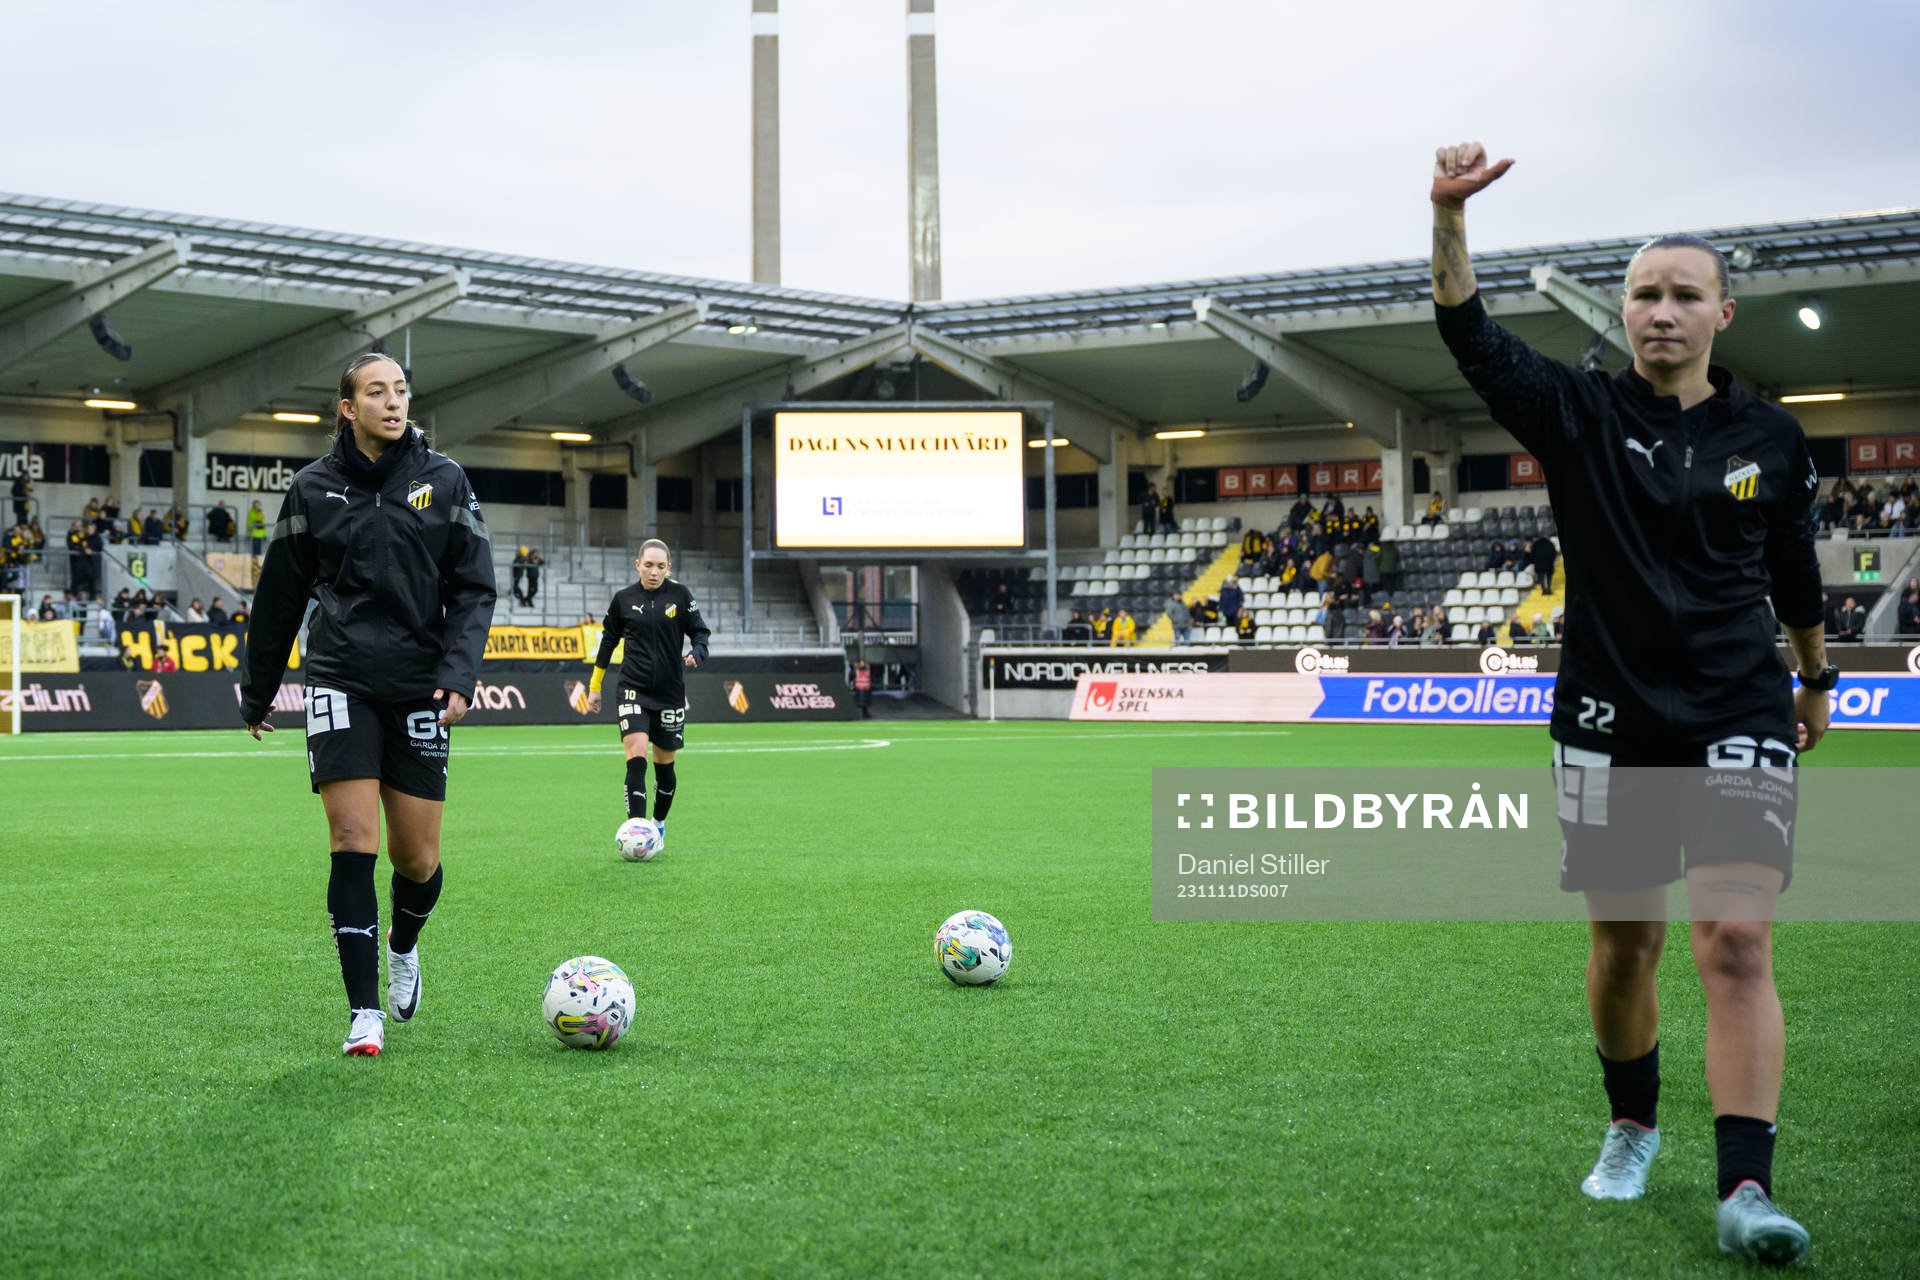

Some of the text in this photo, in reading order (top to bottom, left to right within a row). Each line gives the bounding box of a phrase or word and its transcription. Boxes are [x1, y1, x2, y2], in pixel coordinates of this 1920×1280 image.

[789, 432, 1009, 451] DAGENS MATCHVÄRD
[211, 455, 295, 491] bravida
[1224, 472, 1294, 489] BRA
[131, 559, 145, 578] G
[1860, 552, 1873, 571] F
[624, 688, 637, 701] 10
[775, 683, 821, 697] NORDIC
[1120, 687, 1185, 699] SVENSKA
[769, 695, 836, 710] WELLNESS
[1116, 700, 1150, 712] SPEL
[1577, 695, 1616, 735] 22
